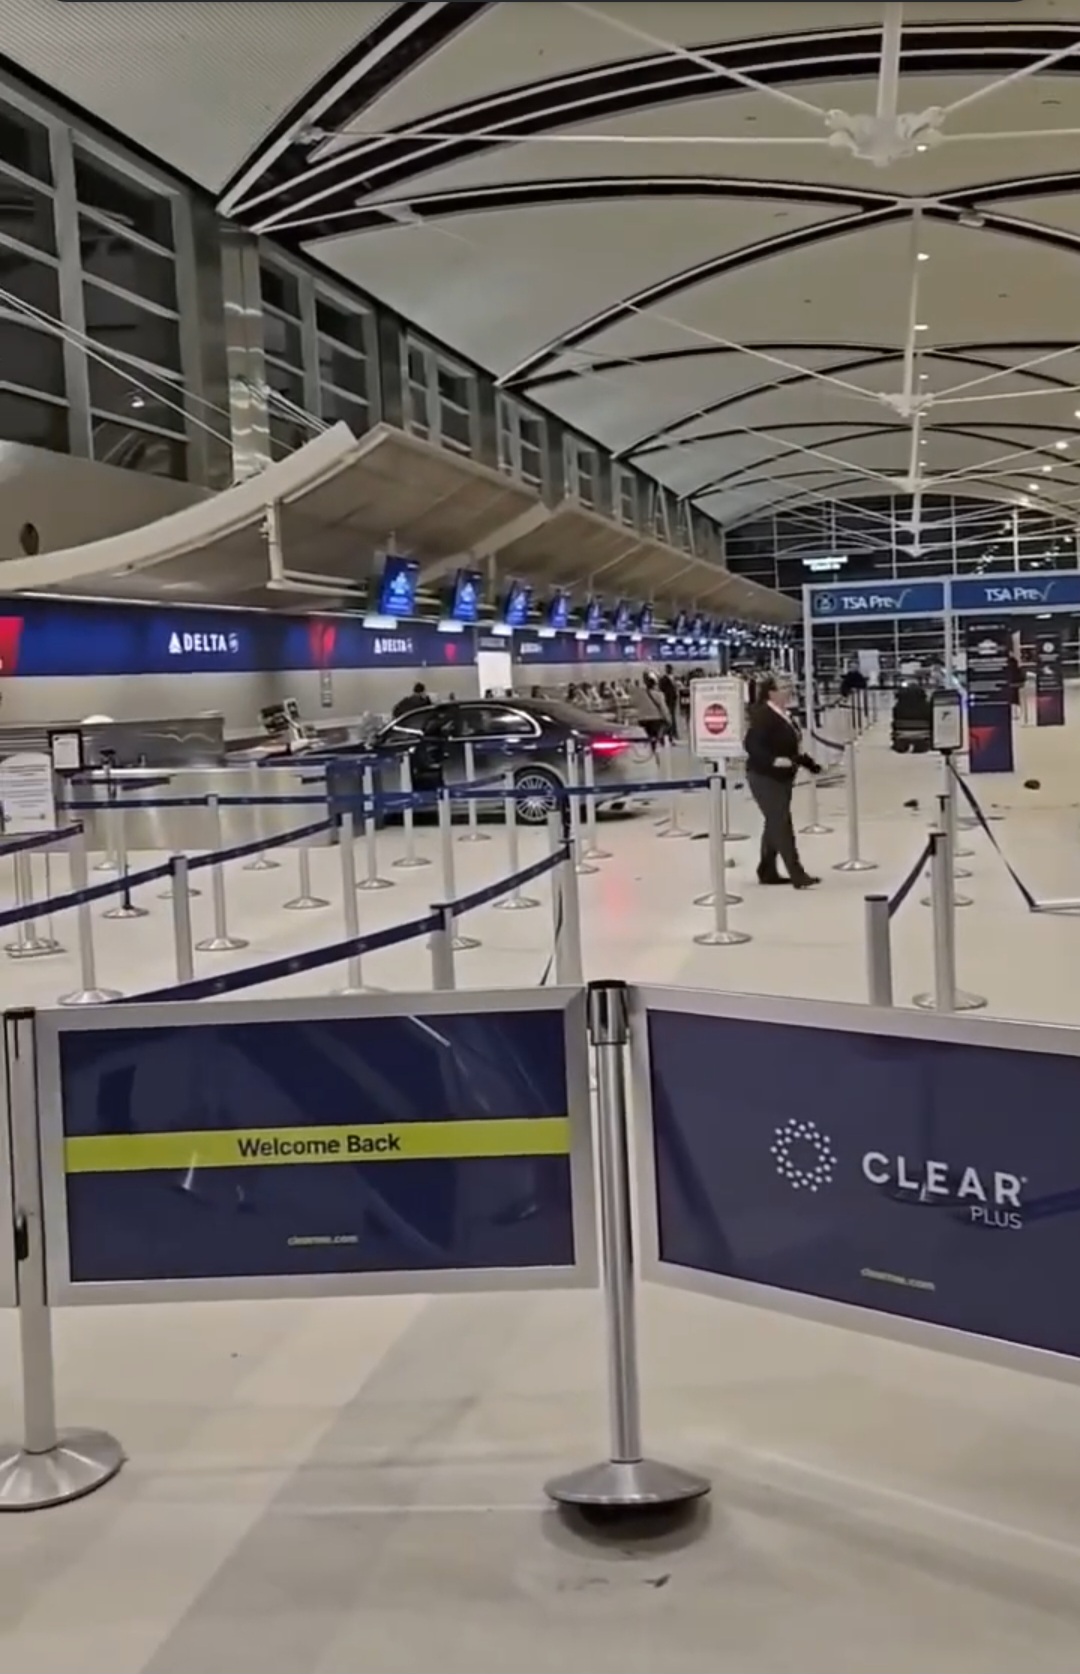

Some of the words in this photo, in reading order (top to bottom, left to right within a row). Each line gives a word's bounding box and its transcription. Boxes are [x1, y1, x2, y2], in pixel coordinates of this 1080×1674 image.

[842, 596, 868, 610] TSA
[984, 587, 1012, 602] TSA
[183, 632, 228, 652] DELTA
[237, 1137, 341, 1157] Welcome
[346, 1133, 401, 1153] Back
[862, 1151, 1021, 1207] CLEAR
[970, 1205, 1023, 1230] PLUS
